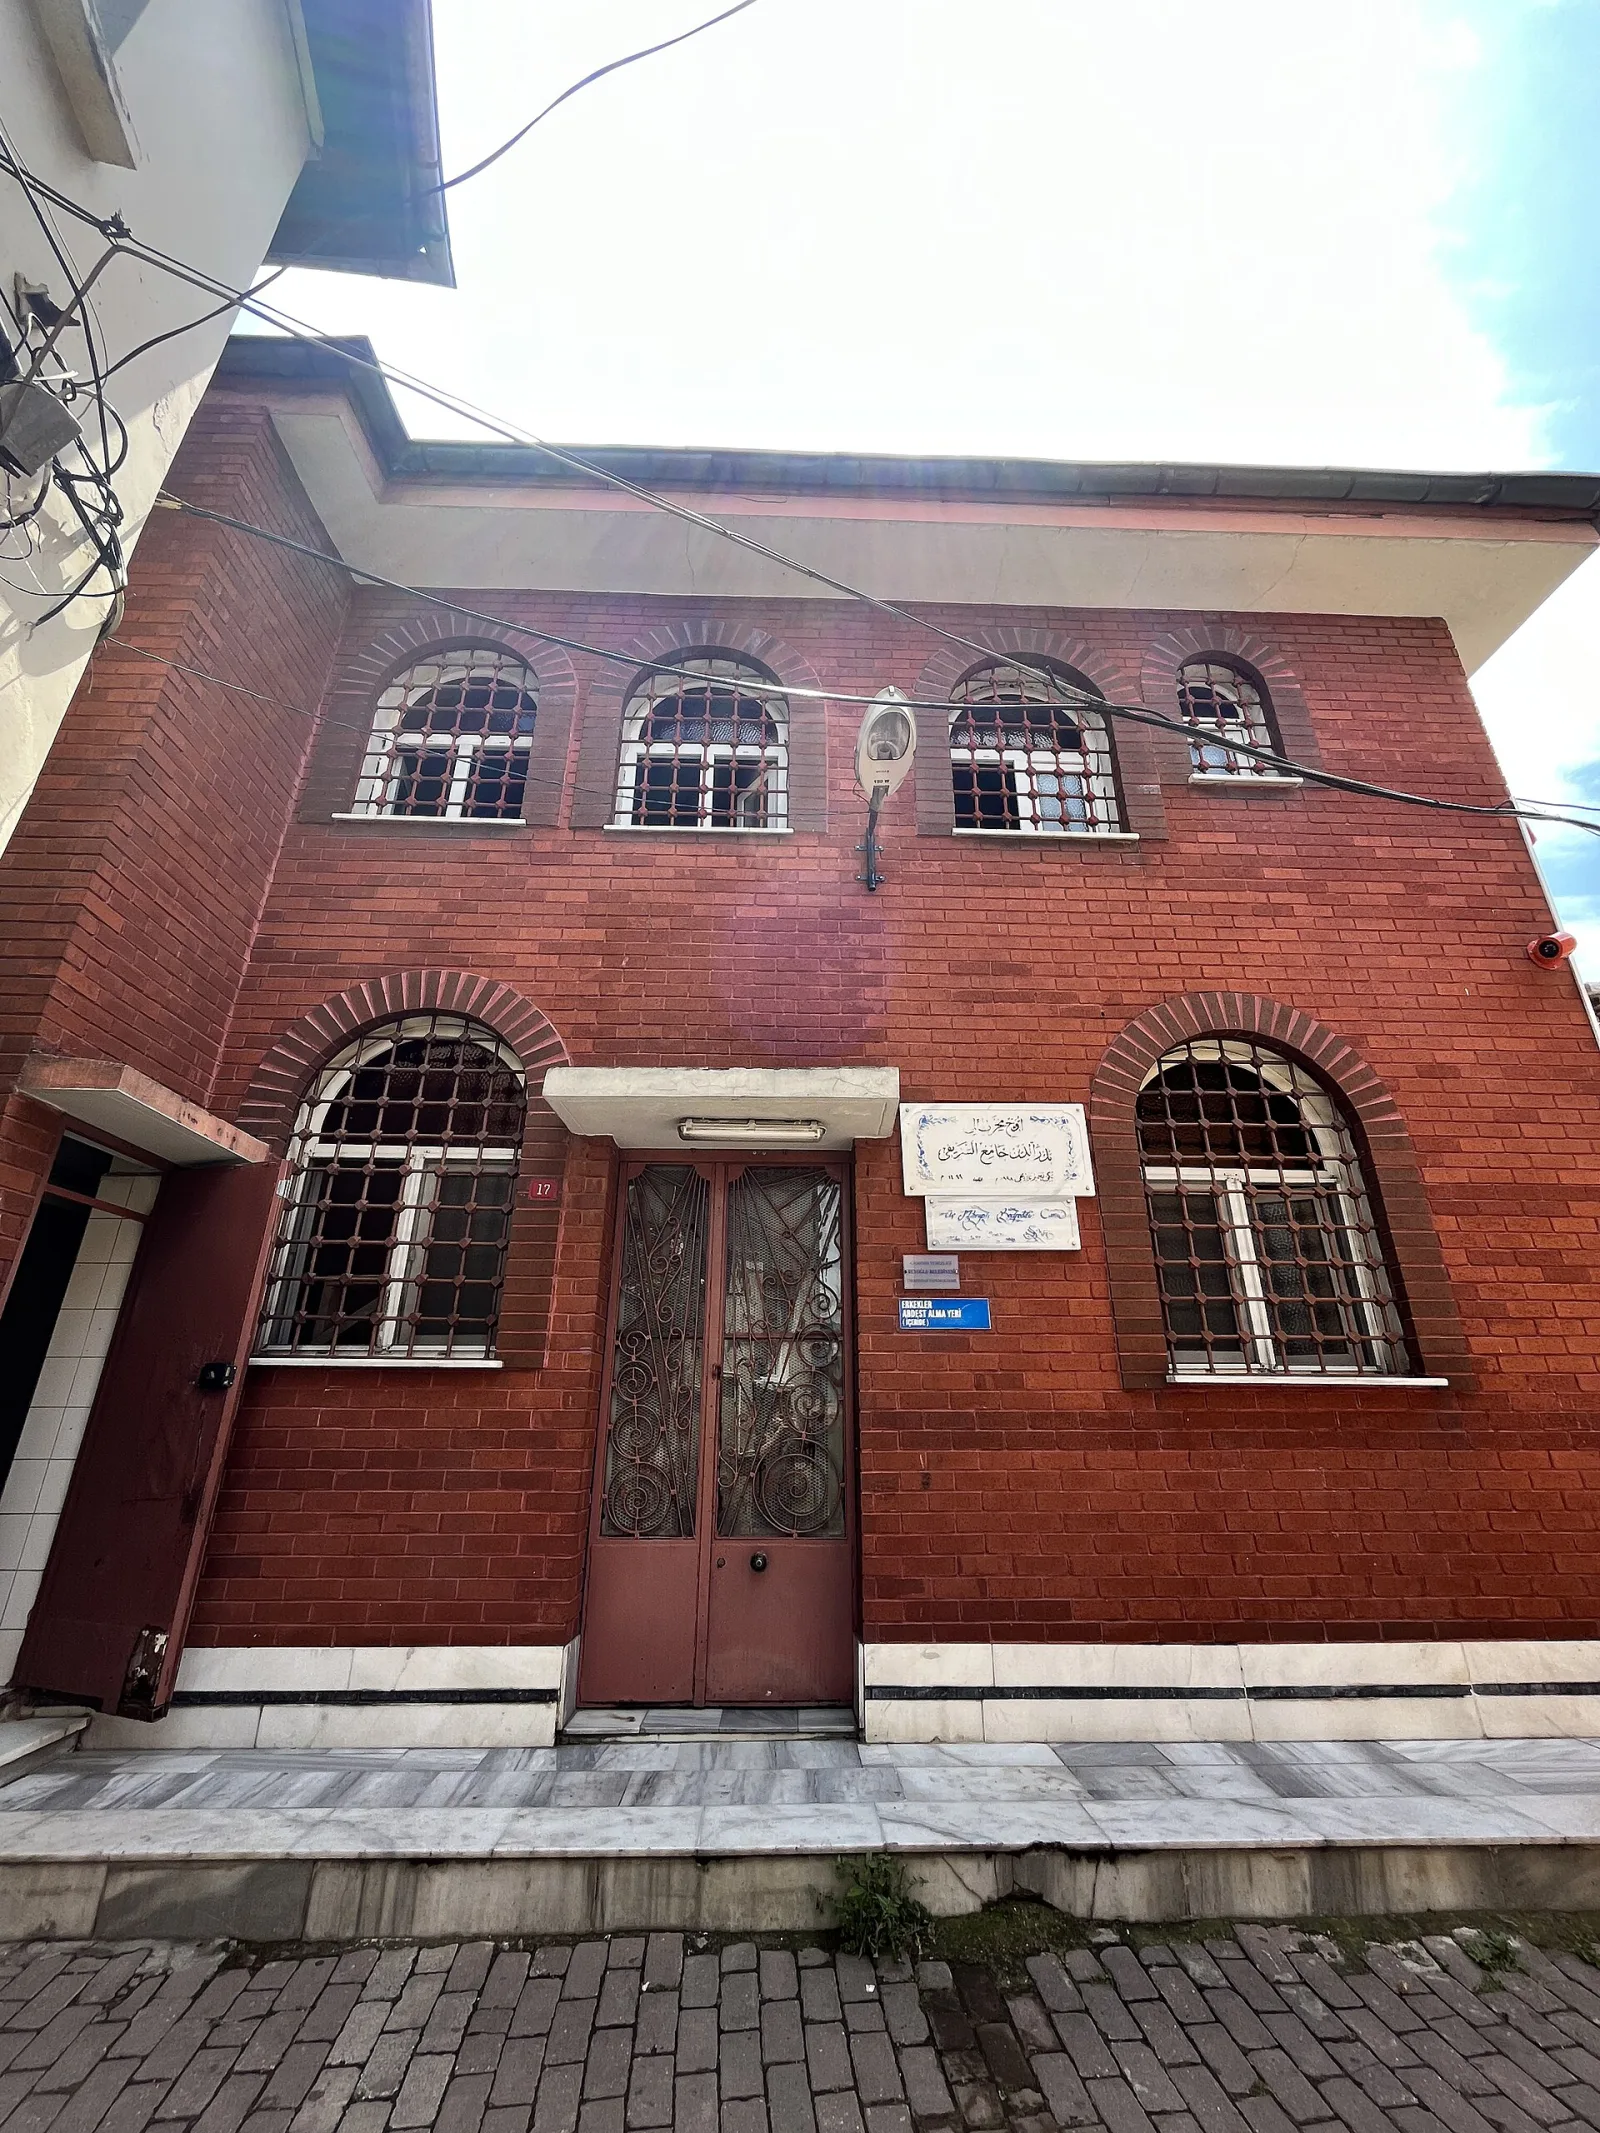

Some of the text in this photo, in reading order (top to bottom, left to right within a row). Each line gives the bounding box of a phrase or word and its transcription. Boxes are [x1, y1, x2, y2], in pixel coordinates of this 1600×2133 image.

[537, 1183, 551, 1195] 17
[901, 1301, 932, 1309] ERKEKLER
[902, 1308, 962, 1318] ABDEST ALMA YERİ
